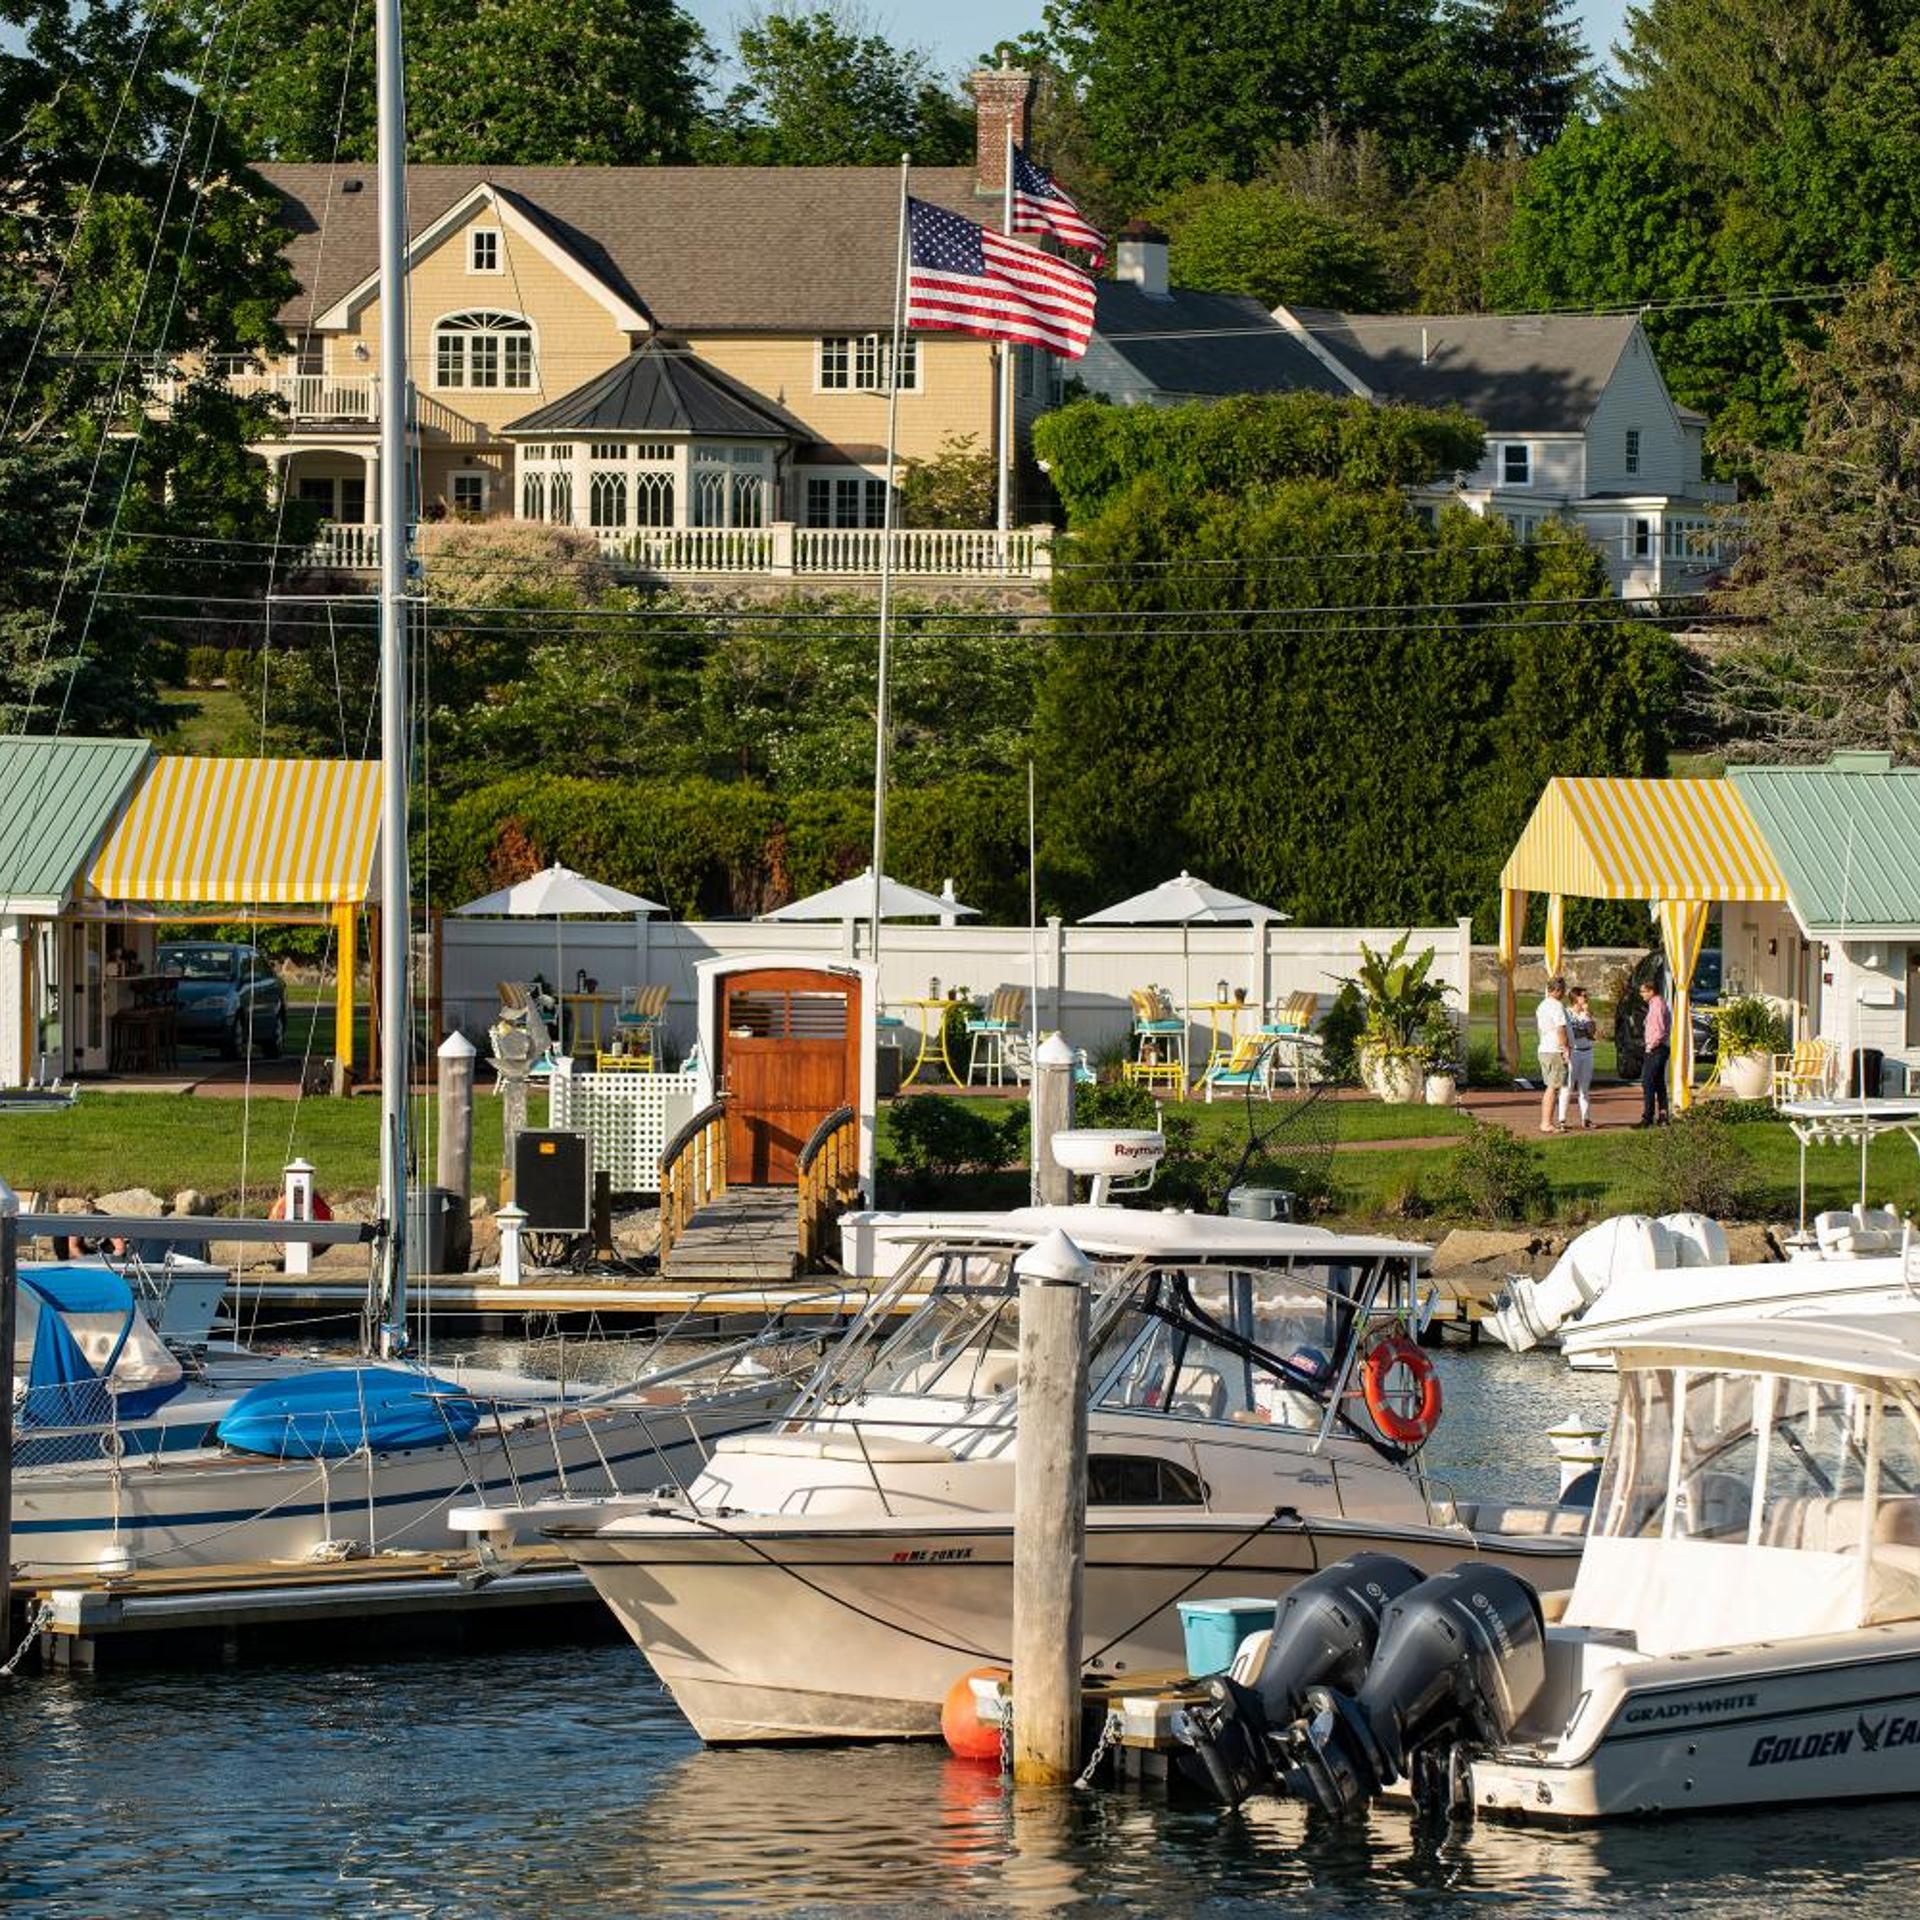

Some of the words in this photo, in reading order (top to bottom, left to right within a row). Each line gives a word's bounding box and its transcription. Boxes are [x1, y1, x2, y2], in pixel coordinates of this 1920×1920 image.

[1625, 1693, 1758, 1723] GRADY-WHITE
[1748, 1730, 1854, 1767] GOLDEN
[1882, 1717, 1920, 1749] EA
